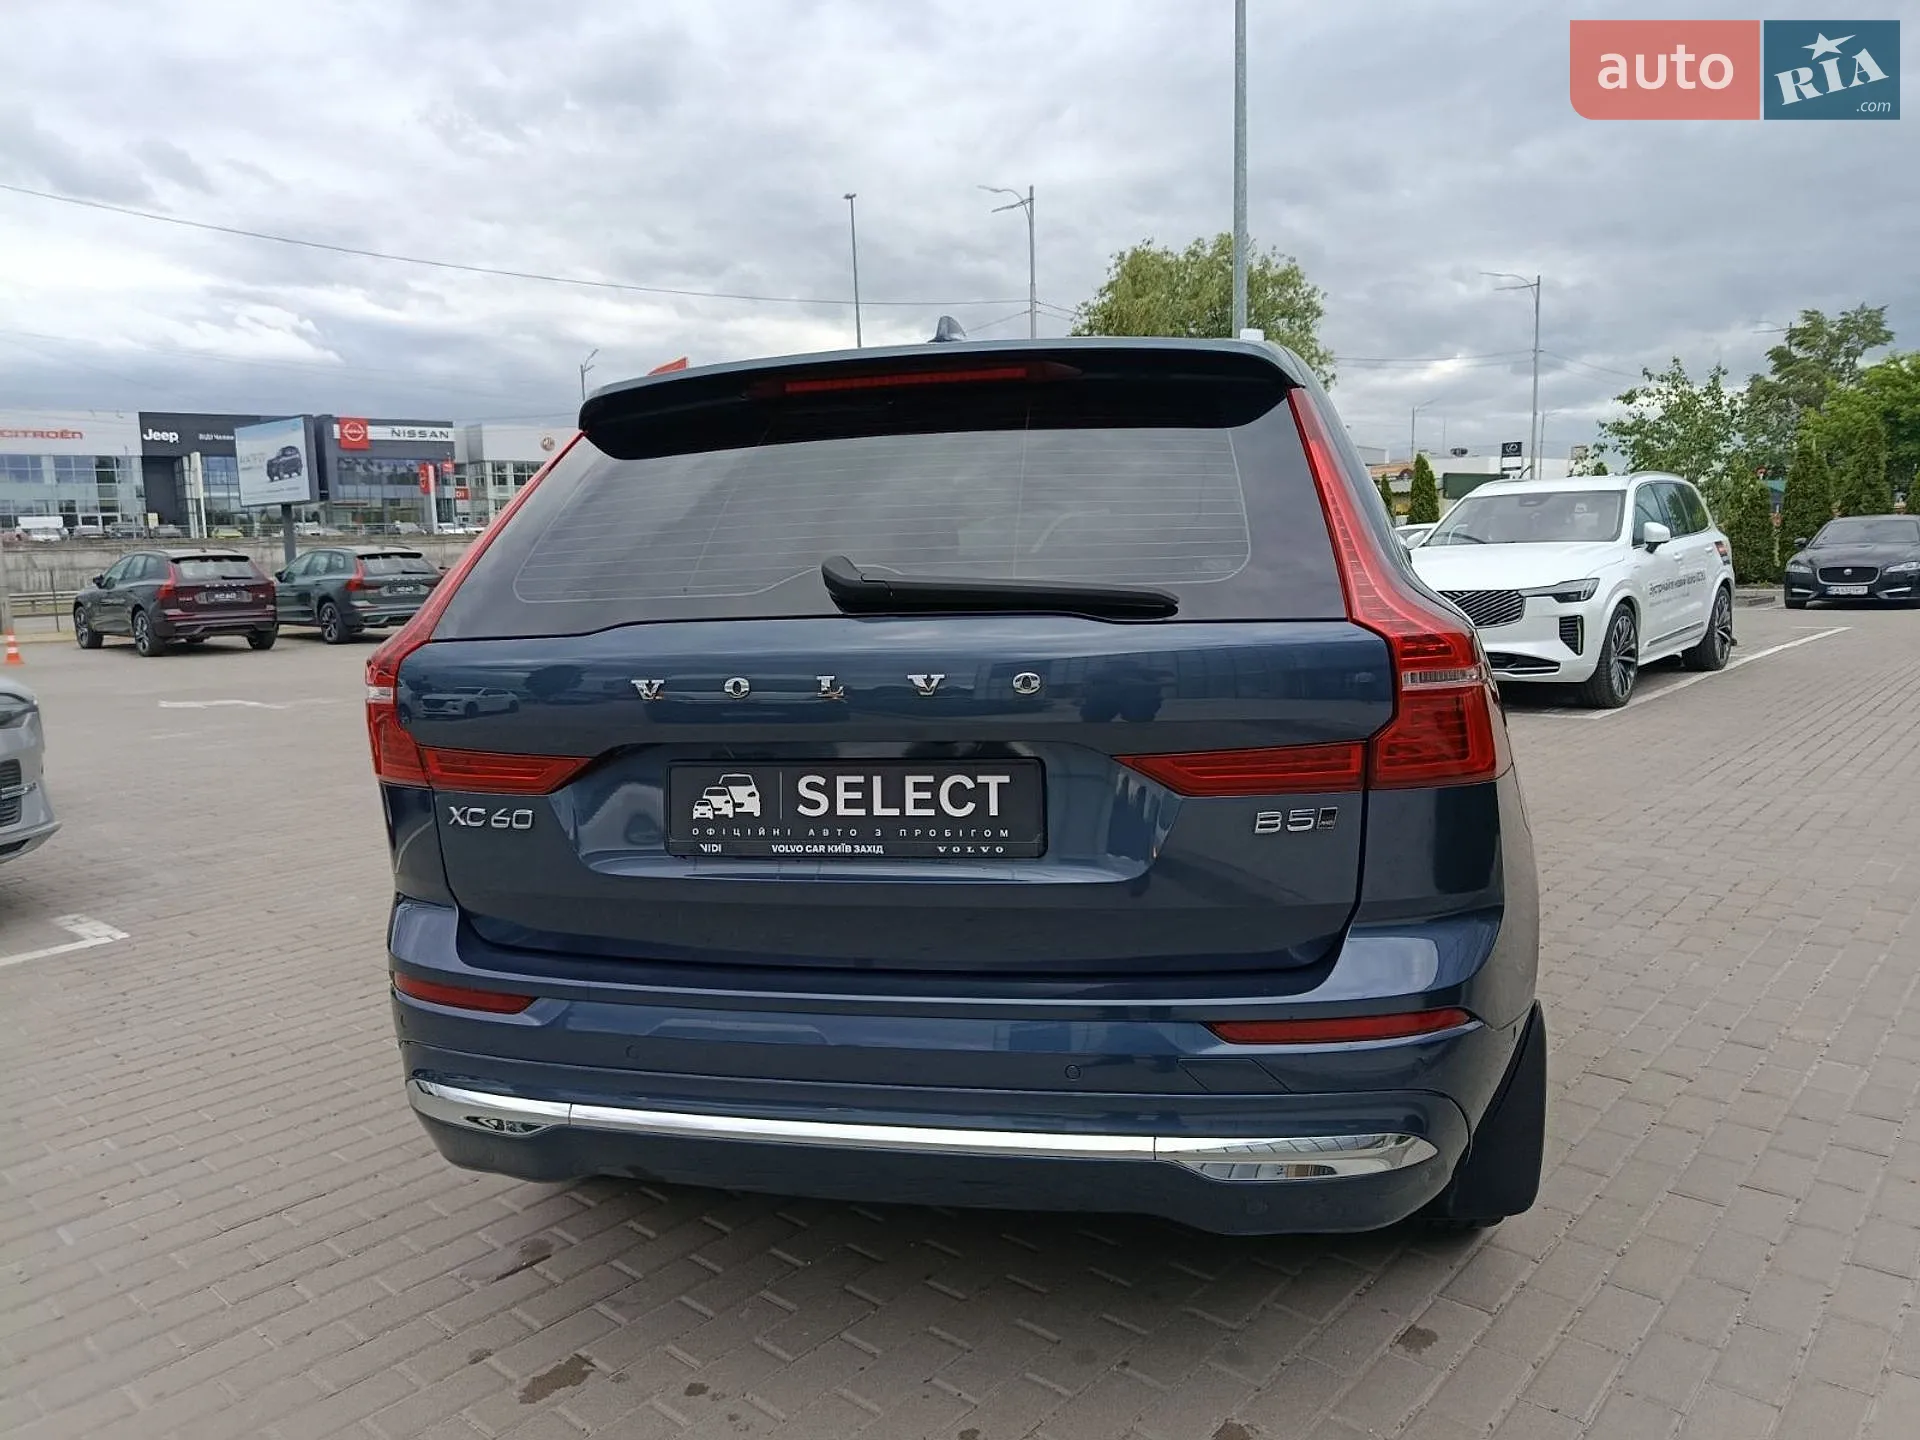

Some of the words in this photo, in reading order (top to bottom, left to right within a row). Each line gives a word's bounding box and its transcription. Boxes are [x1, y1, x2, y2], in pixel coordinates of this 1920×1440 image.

[142, 428, 179, 443] Jeep
[391, 428, 449, 439] NISSAN
[631, 673, 1041, 700] VOLVO
[796, 774, 1010, 818] SELECT
[447, 805, 534, 831] XC60
[1254, 808, 1315, 834] B5
[692, 826, 791, 837] ОФІЦІЙНІ
[808, 827, 857, 837] АВТО
[899, 828, 1009, 838] ПРОБІГОМ
[699, 843, 722, 853] VIDI
[771, 844, 803, 853] VOLVO
[805, 844, 826, 853] CAR
[827, 843, 852, 853] КИЇВ
[853, 844, 884, 855] ЗАХІД
[937, 845, 1004, 853] VOLVO
